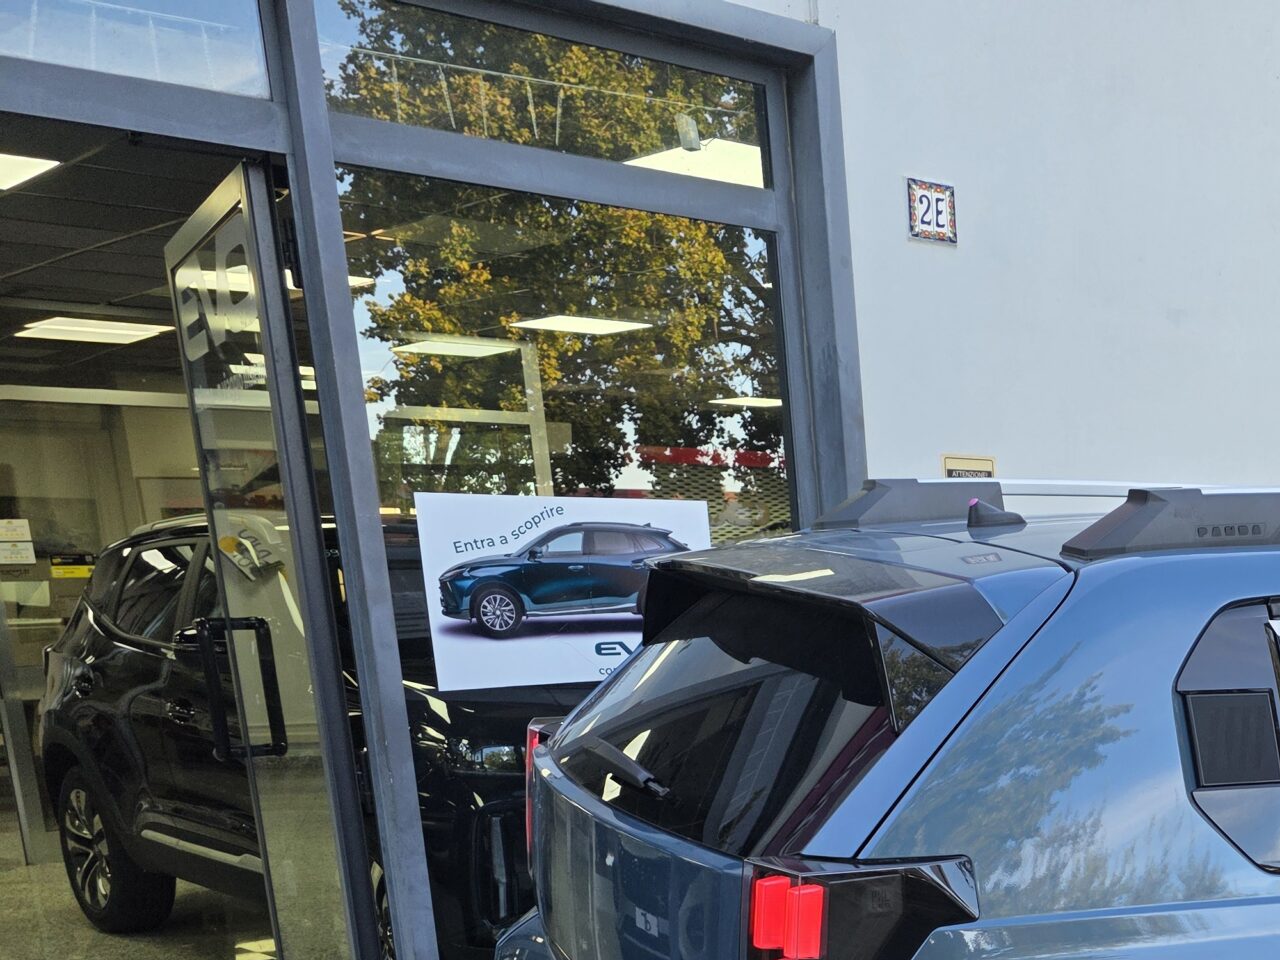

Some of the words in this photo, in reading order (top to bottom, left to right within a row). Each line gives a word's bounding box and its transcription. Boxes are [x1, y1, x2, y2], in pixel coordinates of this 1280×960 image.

[919, 194, 945, 228] 2E
[453, 538, 496, 554] Entra
[500, 534, 509, 545] a
[511, 504, 565, 541] scoprire
[595, 641, 633, 656] EV
